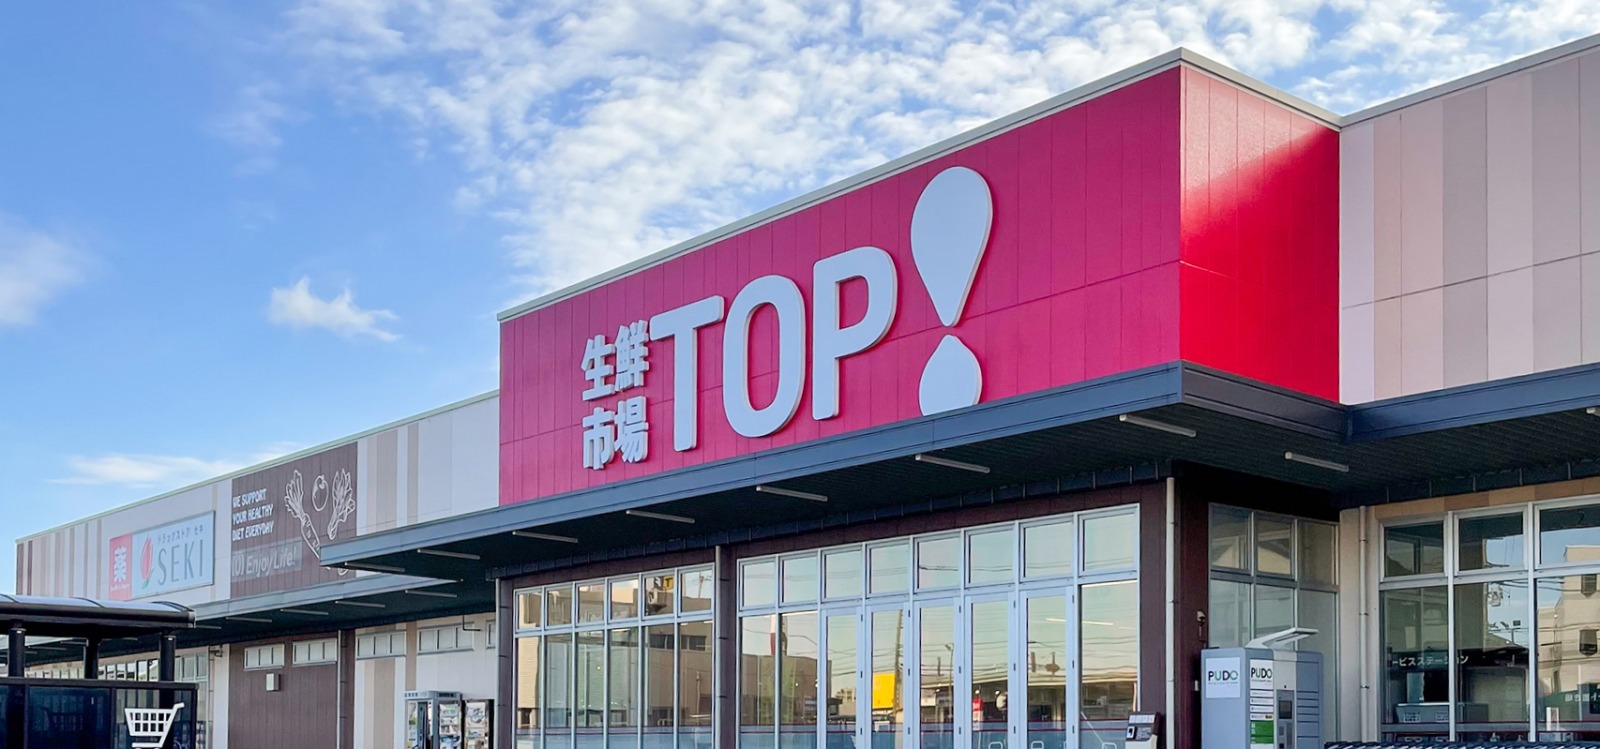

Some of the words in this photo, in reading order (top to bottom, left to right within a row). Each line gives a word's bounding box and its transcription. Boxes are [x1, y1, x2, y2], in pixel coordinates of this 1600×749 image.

[650, 166, 993, 452] TOP!
[581, 320, 650, 401] 生鮮
[582, 396, 649, 470] 市場
[233, 496, 241, 508] WE
[241, 489, 267, 506] SUPPORT
[233, 510, 247, 525] YOUR
[247, 504, 273, 521] HEALTHY
[232, 527, 245, 541] DIET
[245, 521, 274, 539] EVERYDAY
[113, 546, 127, 582] 薬
[158, 539, 203, 586] SEKI
[246, 555, 273, 577] Enjoy
[273, 546, 296, 570] Life!
[1208, 670, 1239, 681] PUDO
[1251, 667, 1273, 679] PUDO
